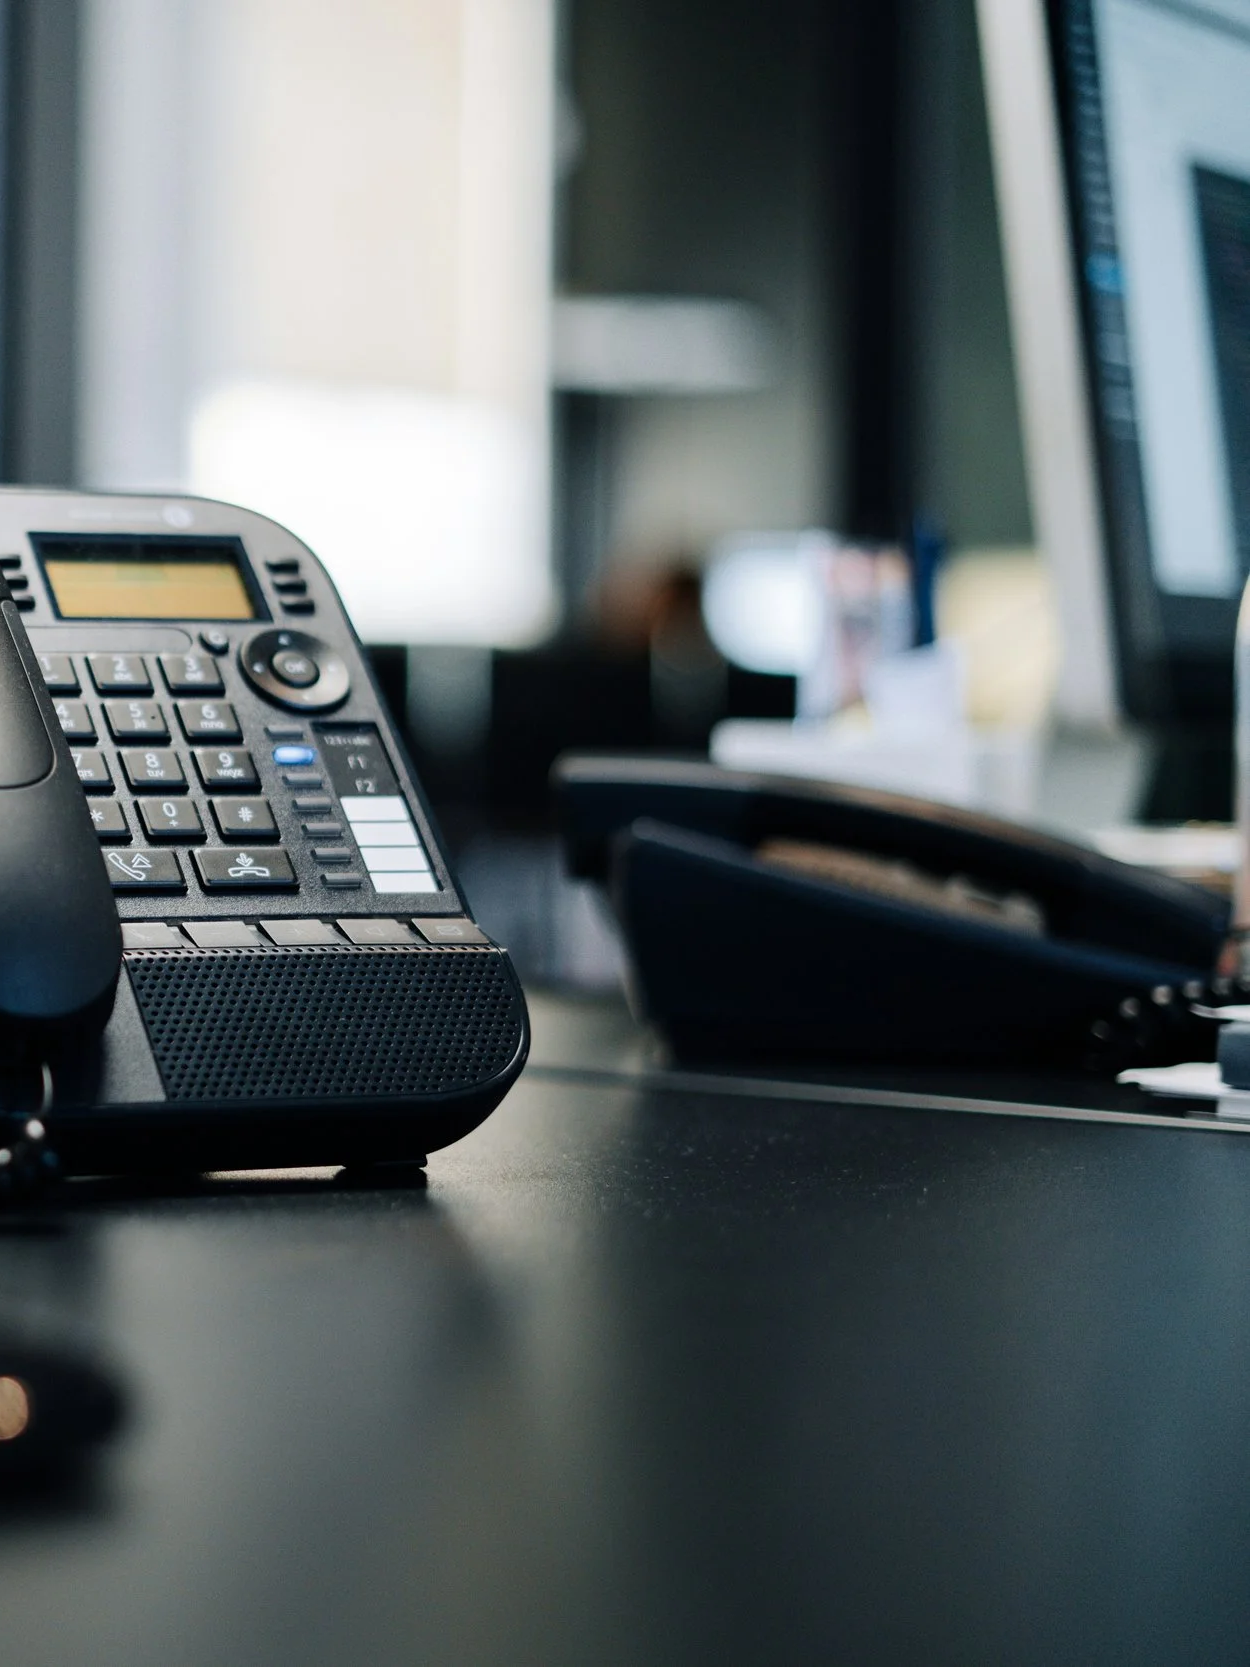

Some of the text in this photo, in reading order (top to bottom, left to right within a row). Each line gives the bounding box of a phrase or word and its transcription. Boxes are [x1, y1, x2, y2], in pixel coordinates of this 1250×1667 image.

[112, 655, 126, 671] 2
[184, 655, 197, 671] 3
[56, 704, 68, 717] 4
[129, 703, 141, 717] 5
[201, 704, 216, 719] 6
[144, 753, 159, 768] 8
[218, 752, 233, 767] 9
[146, 769, 164, 777] tuv
[162, 802, 177, 817] 0
